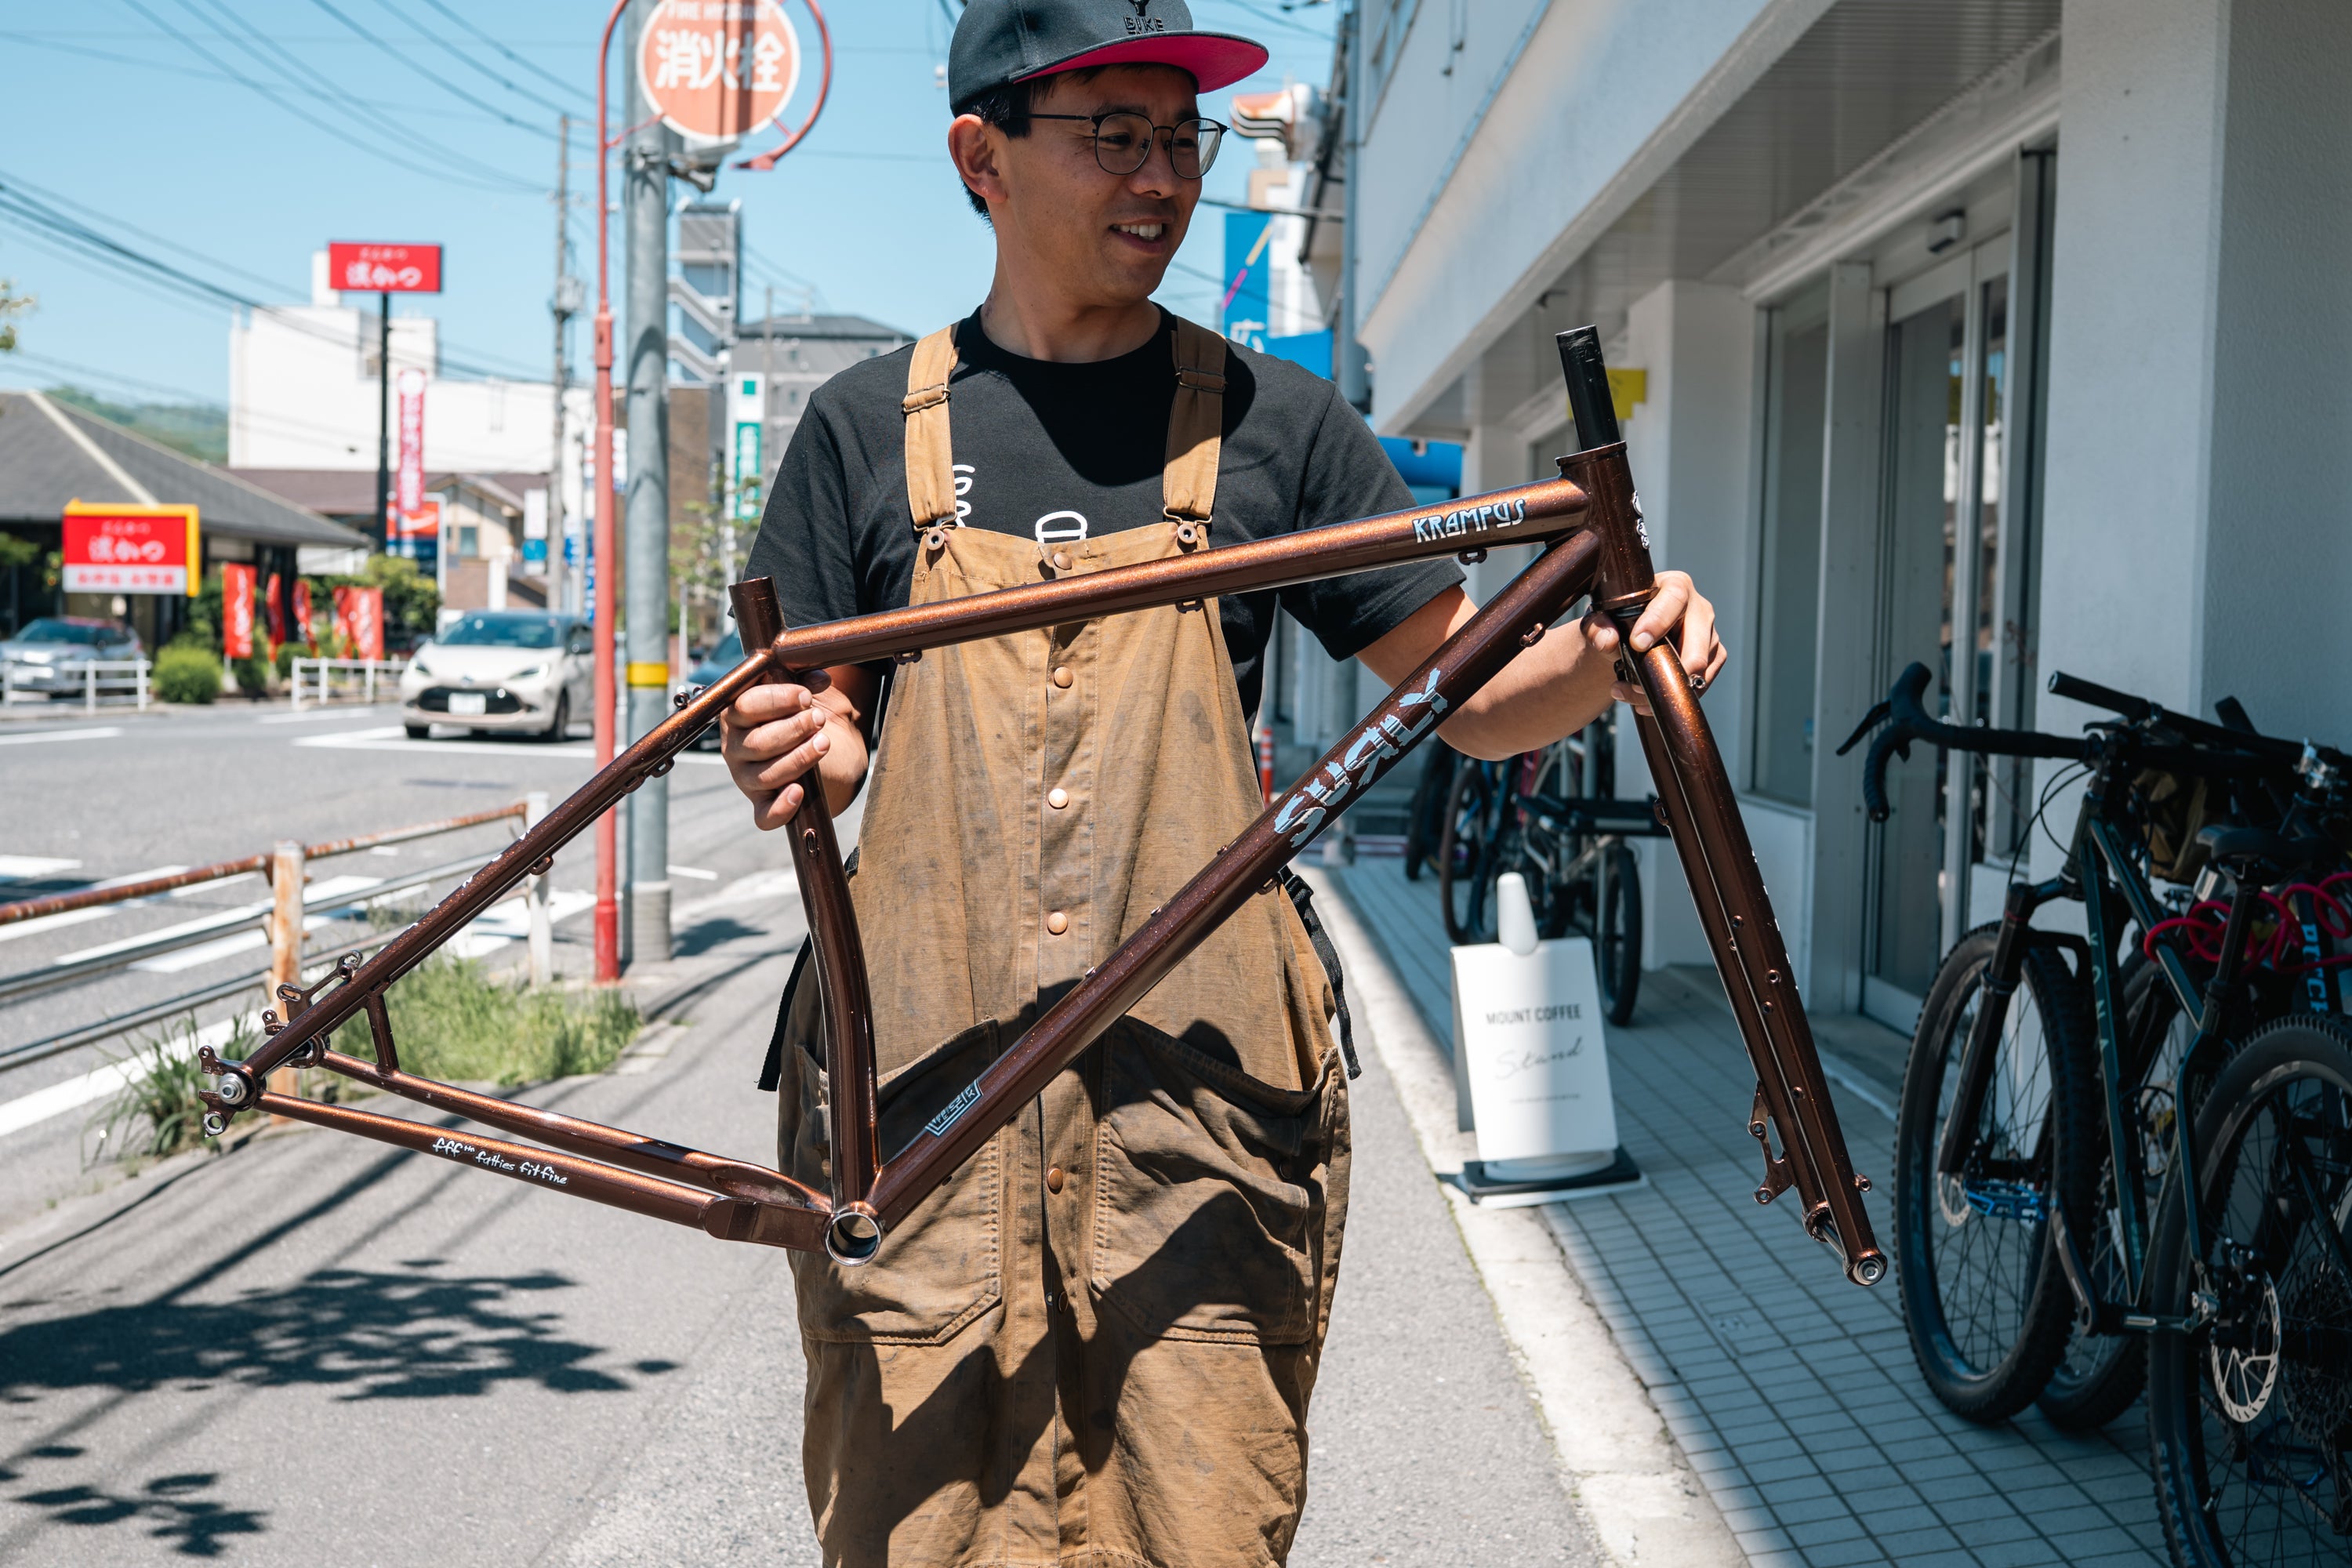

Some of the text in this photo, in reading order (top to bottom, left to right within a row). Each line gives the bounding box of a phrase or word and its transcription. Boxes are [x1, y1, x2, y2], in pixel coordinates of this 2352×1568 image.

[1123, 16, 1164, 31] BIKE
[655, 29, 785, 92] 消火栓
[1412, 498, 1526, 543] KRAMPUS
[1273, 667, 1448, 848] SURLY
[1486, 1004, 1581, 1025] MOUNT COFFEE
